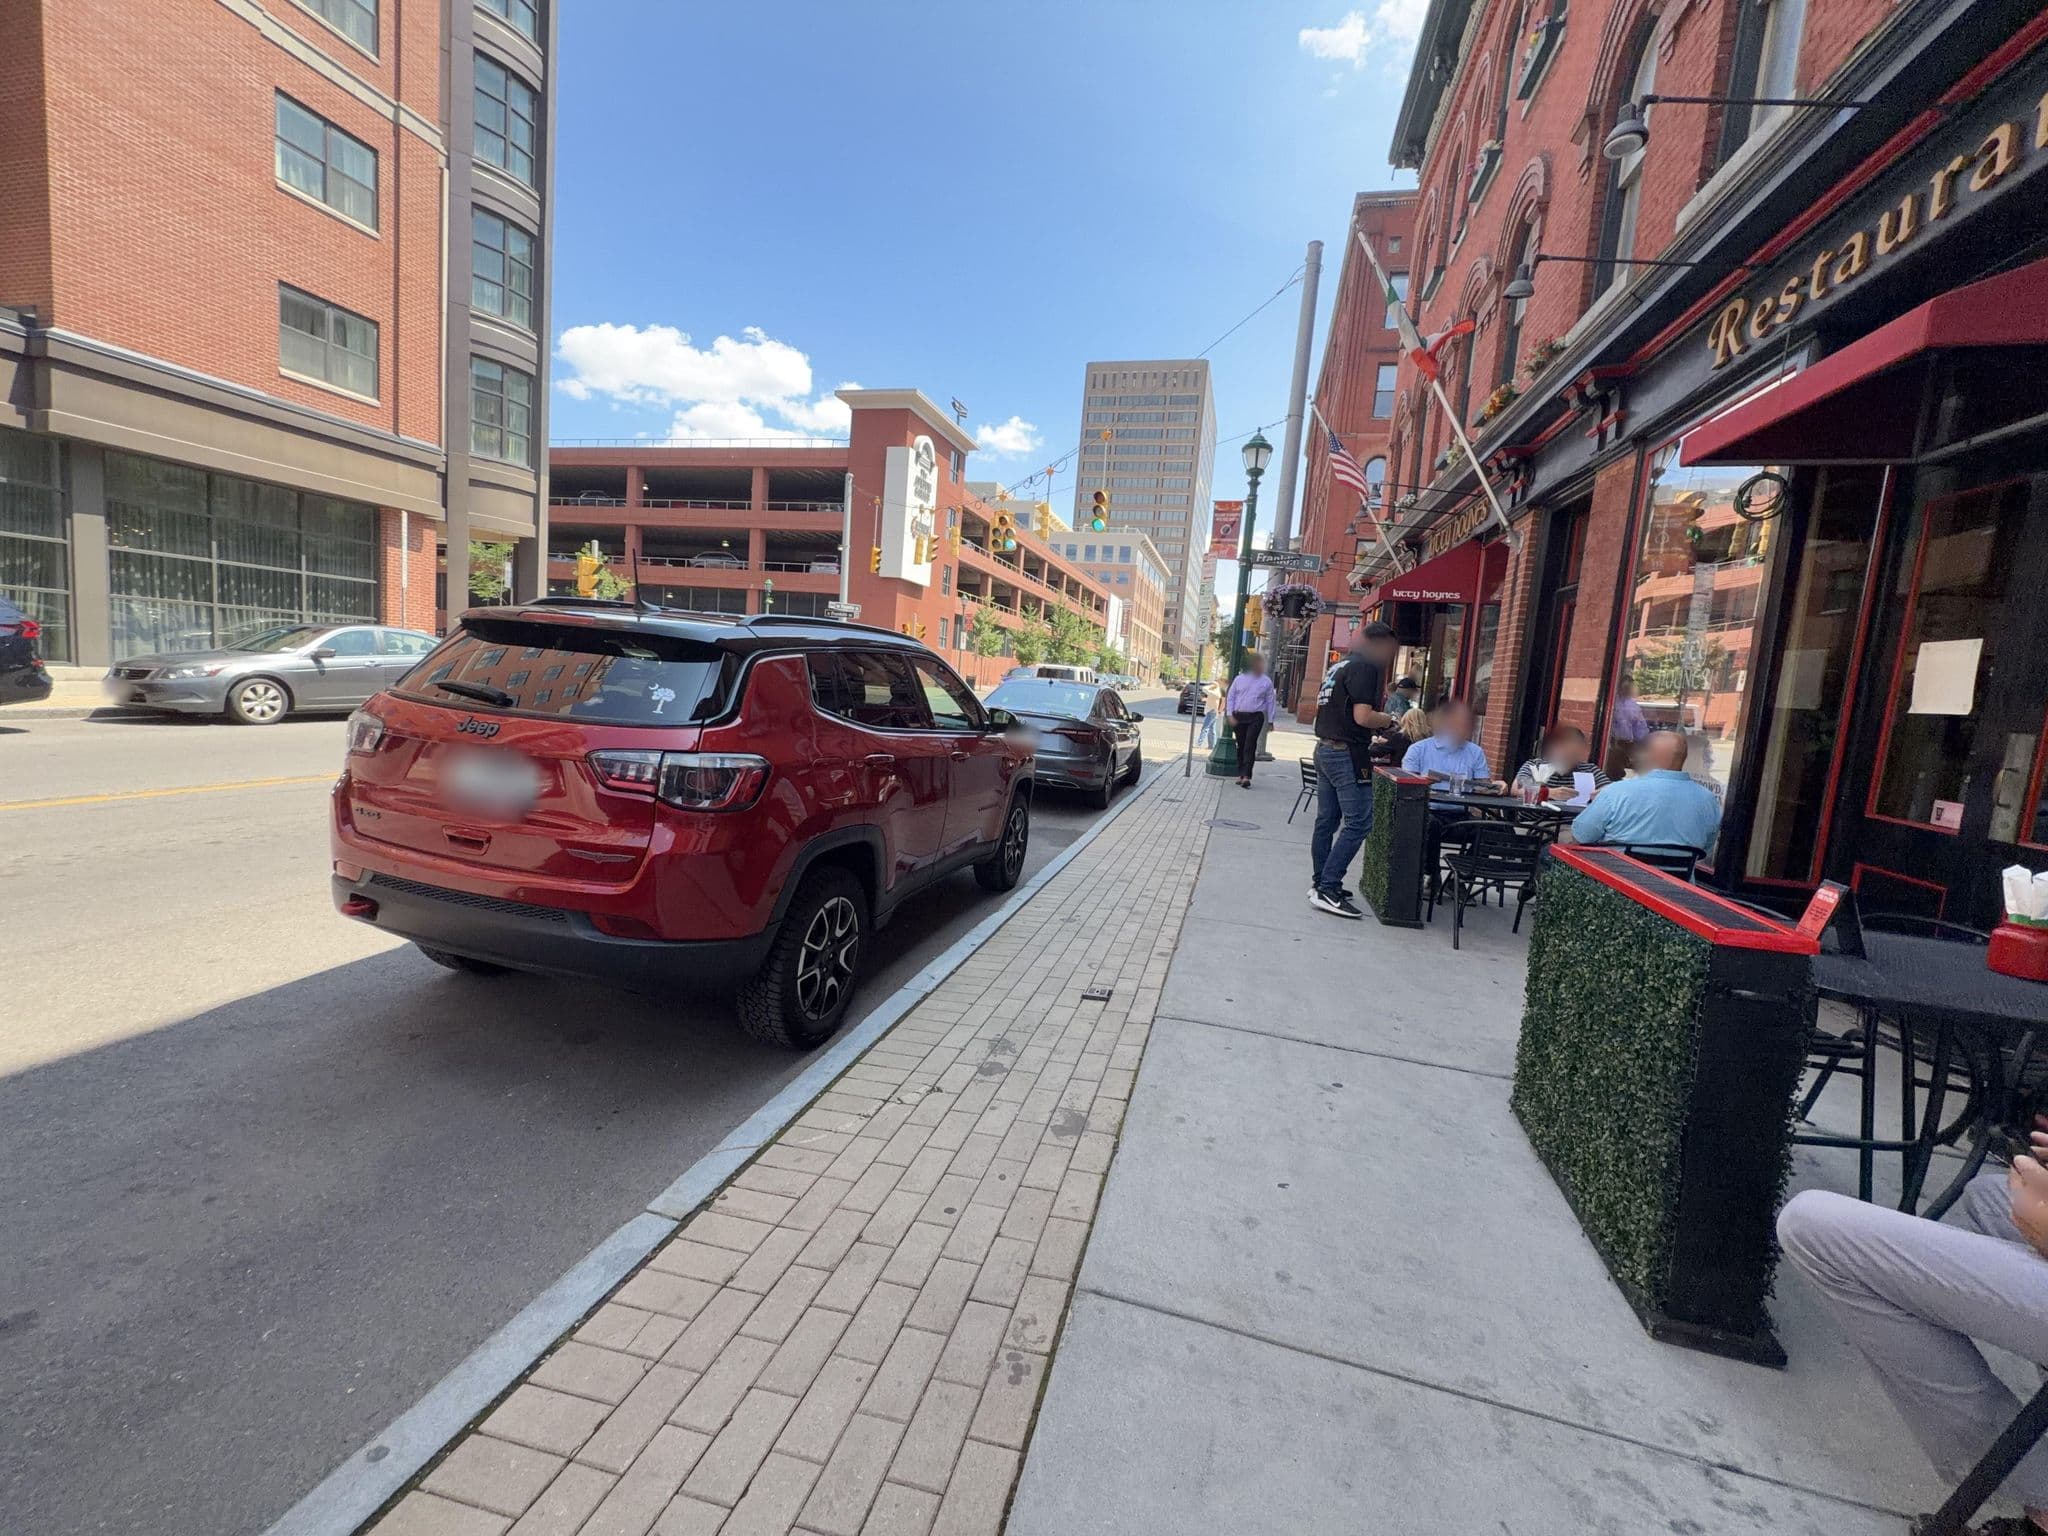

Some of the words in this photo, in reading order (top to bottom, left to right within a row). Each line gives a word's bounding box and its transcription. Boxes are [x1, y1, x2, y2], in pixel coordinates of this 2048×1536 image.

[1256, 553, 1300, 567] Franklin
[1303, 559, 1313, 568] St
[456, 716, 500, 739] Jeep
